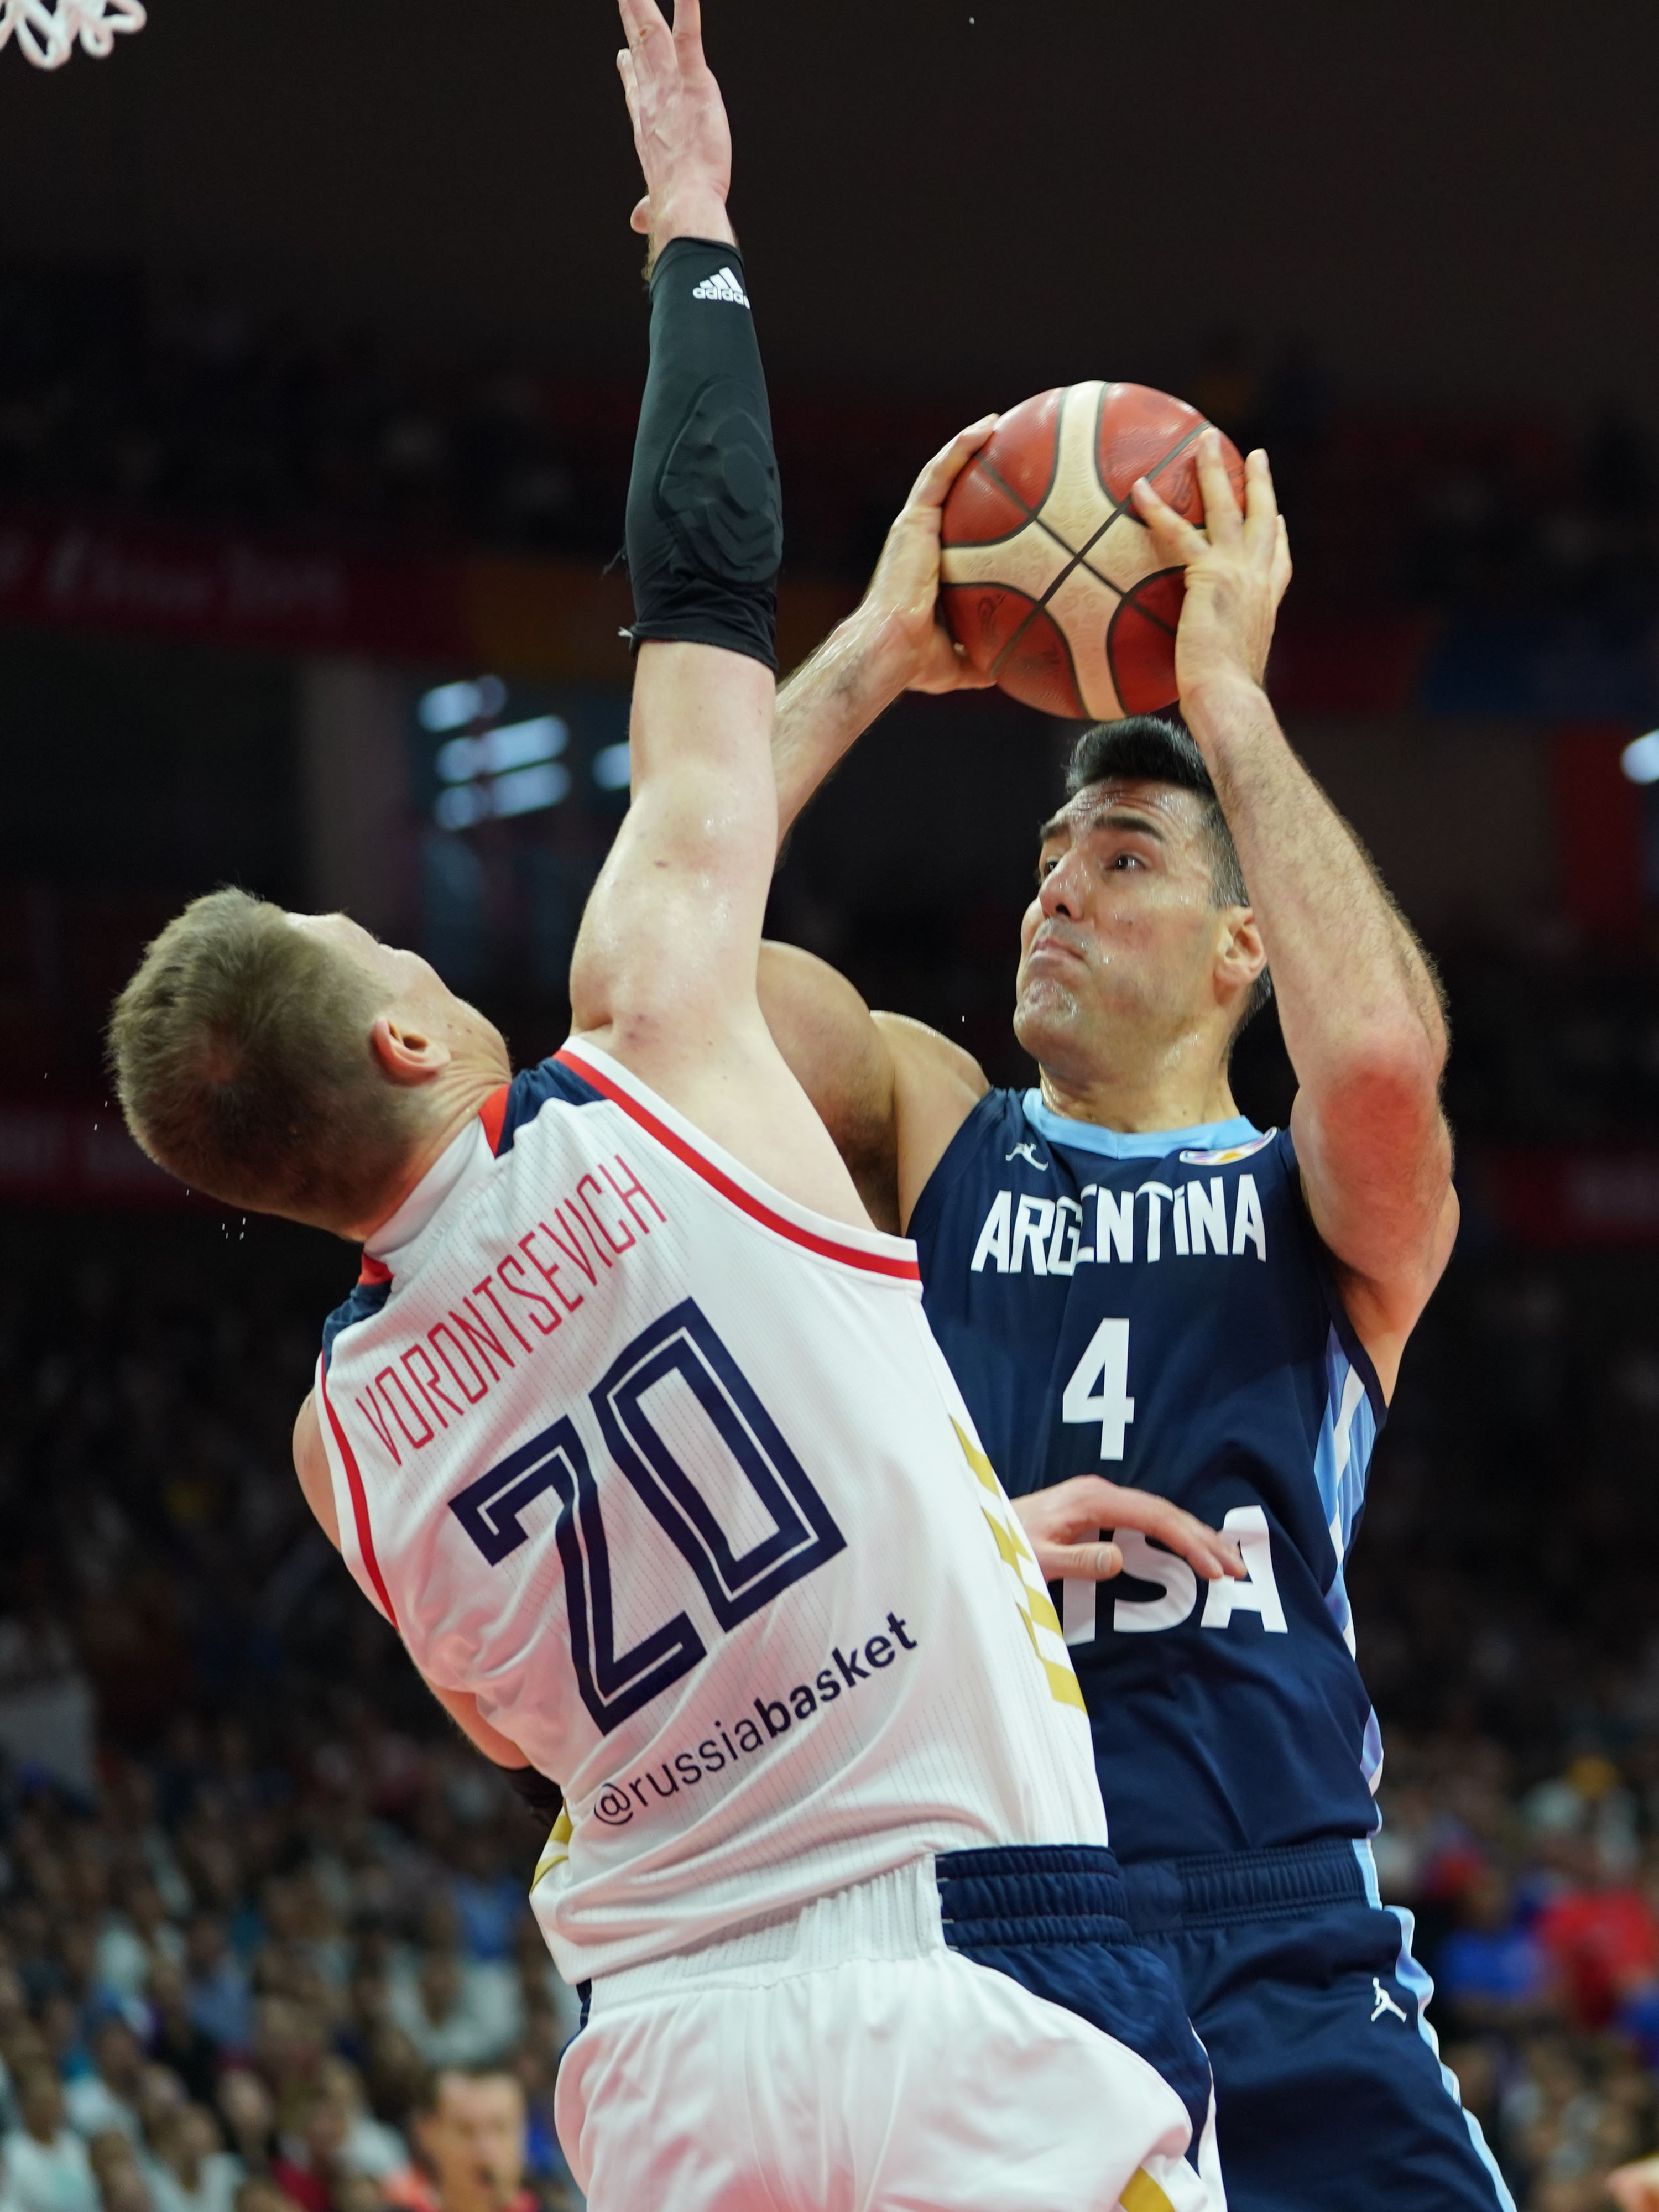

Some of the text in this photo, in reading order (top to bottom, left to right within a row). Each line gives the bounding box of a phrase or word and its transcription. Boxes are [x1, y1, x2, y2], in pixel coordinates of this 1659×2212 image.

[355, 1155, 667, 1467] VORONTSEVICH
[1062, 1317, 1135, 1461] 4
[447, 1296, 848, 1737] 20
[1063, 1505, 1288, 1647] ISA
[593, 1611, 919, 1827] @russiabasket
